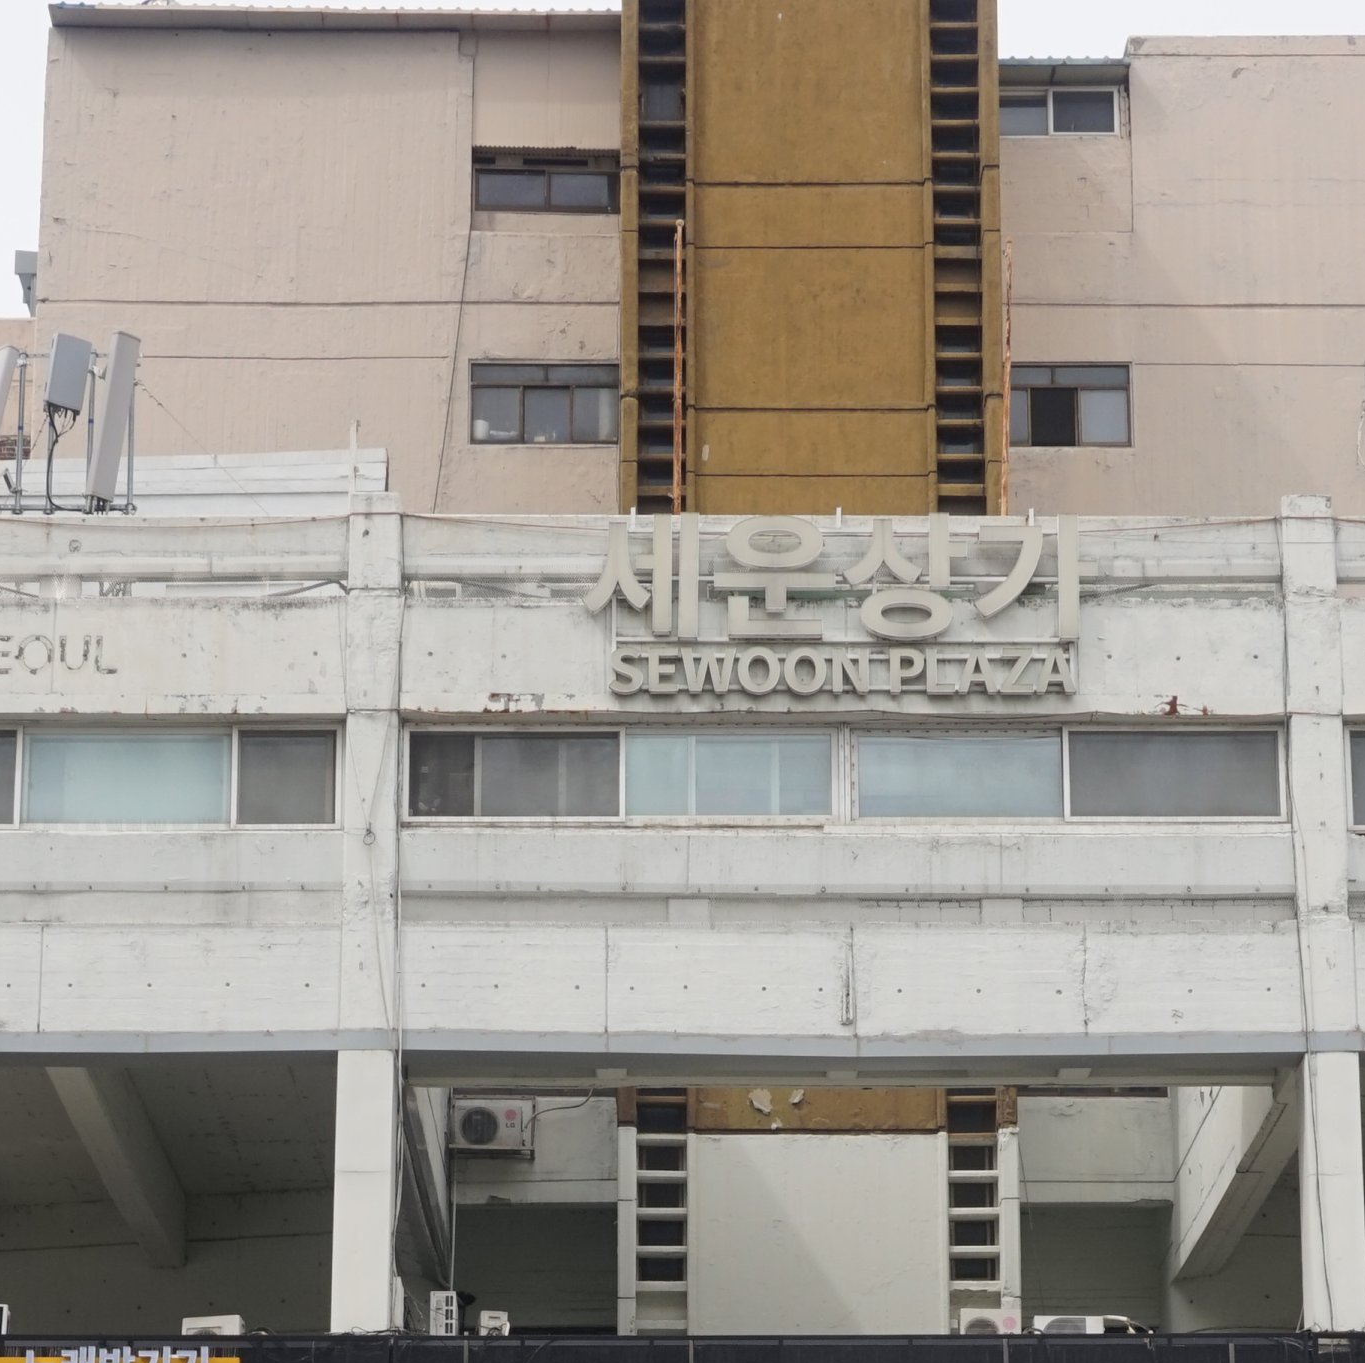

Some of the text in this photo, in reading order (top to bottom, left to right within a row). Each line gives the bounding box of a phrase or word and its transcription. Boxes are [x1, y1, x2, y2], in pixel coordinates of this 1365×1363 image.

[583, 512, 1099, 641] 세운상가
[609, 647, 1077, 696] SEWOON PLAZA
